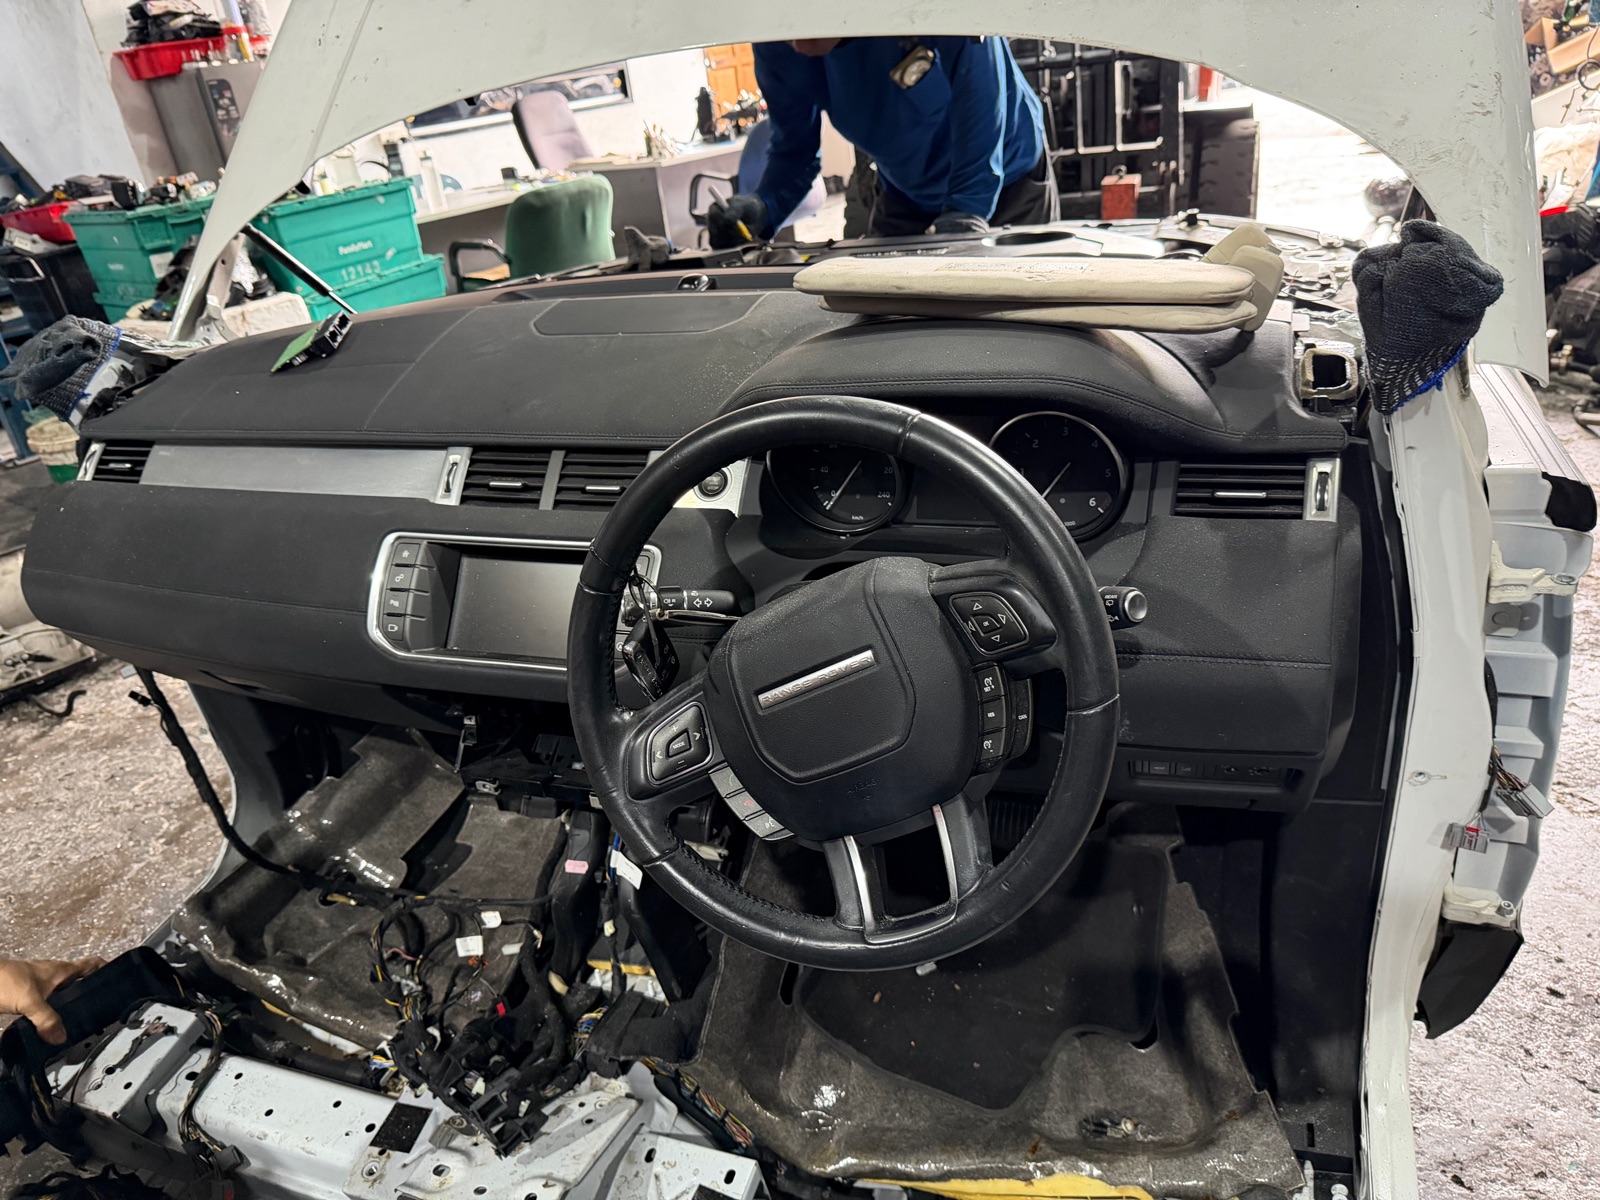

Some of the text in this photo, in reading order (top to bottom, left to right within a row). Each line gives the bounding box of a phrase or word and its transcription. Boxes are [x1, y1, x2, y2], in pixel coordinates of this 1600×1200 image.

[1062, 427, 1068, 435] 3
[1032, 440, 1039, 448] 2
[1091, 440, 1098, 448] 4
[1105, 469, 1111, 477] 5
[1089, 498, 1096, 507] 6
[761, 656, 874, 703] RANGE ROVER
